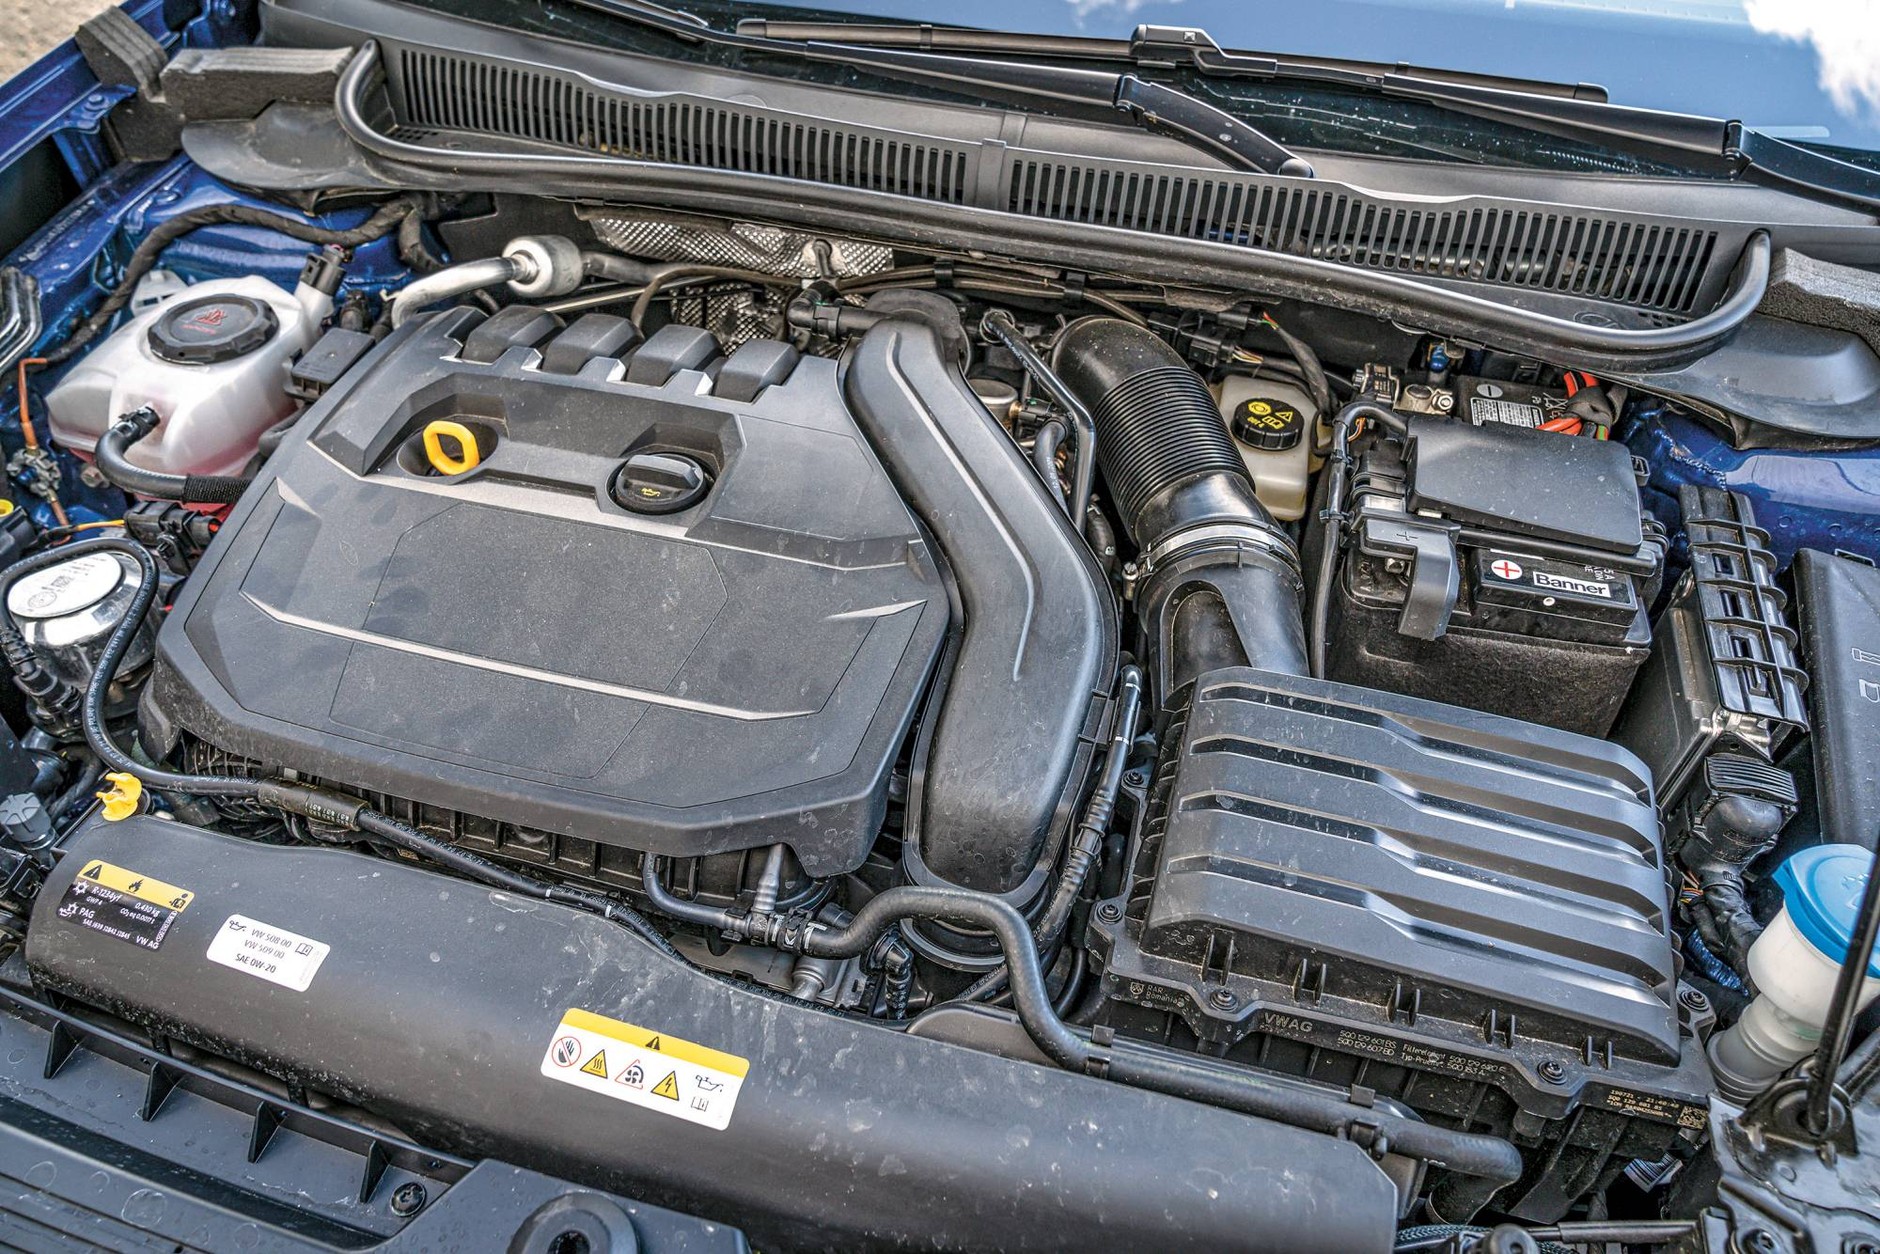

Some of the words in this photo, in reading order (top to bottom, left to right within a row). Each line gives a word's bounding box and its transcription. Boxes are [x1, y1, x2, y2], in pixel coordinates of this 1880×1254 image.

[1536, 574, 1607, 595] Banner
[92, 886, 123, 902] R-1234yf
[152, 907, 160, 918] kg
[79, 908, 96, 919] PAG
[135, 936, 148, 946] VW
[147, 940, 160, 950] AG
[252, 928, 266, 938] VW
[266, 934, 281, 944] 508
[280, 938, 292, 948] 00
[244, 940, 258, 950] VW
[273, 950, 285, 960] 00
[235, 954, 249, 964] SAE
[250, 957, 276, 973] 0W-20
[1146, 992, 1178, 1004] Romania
[1147, 984, 1164, 994] RAR
